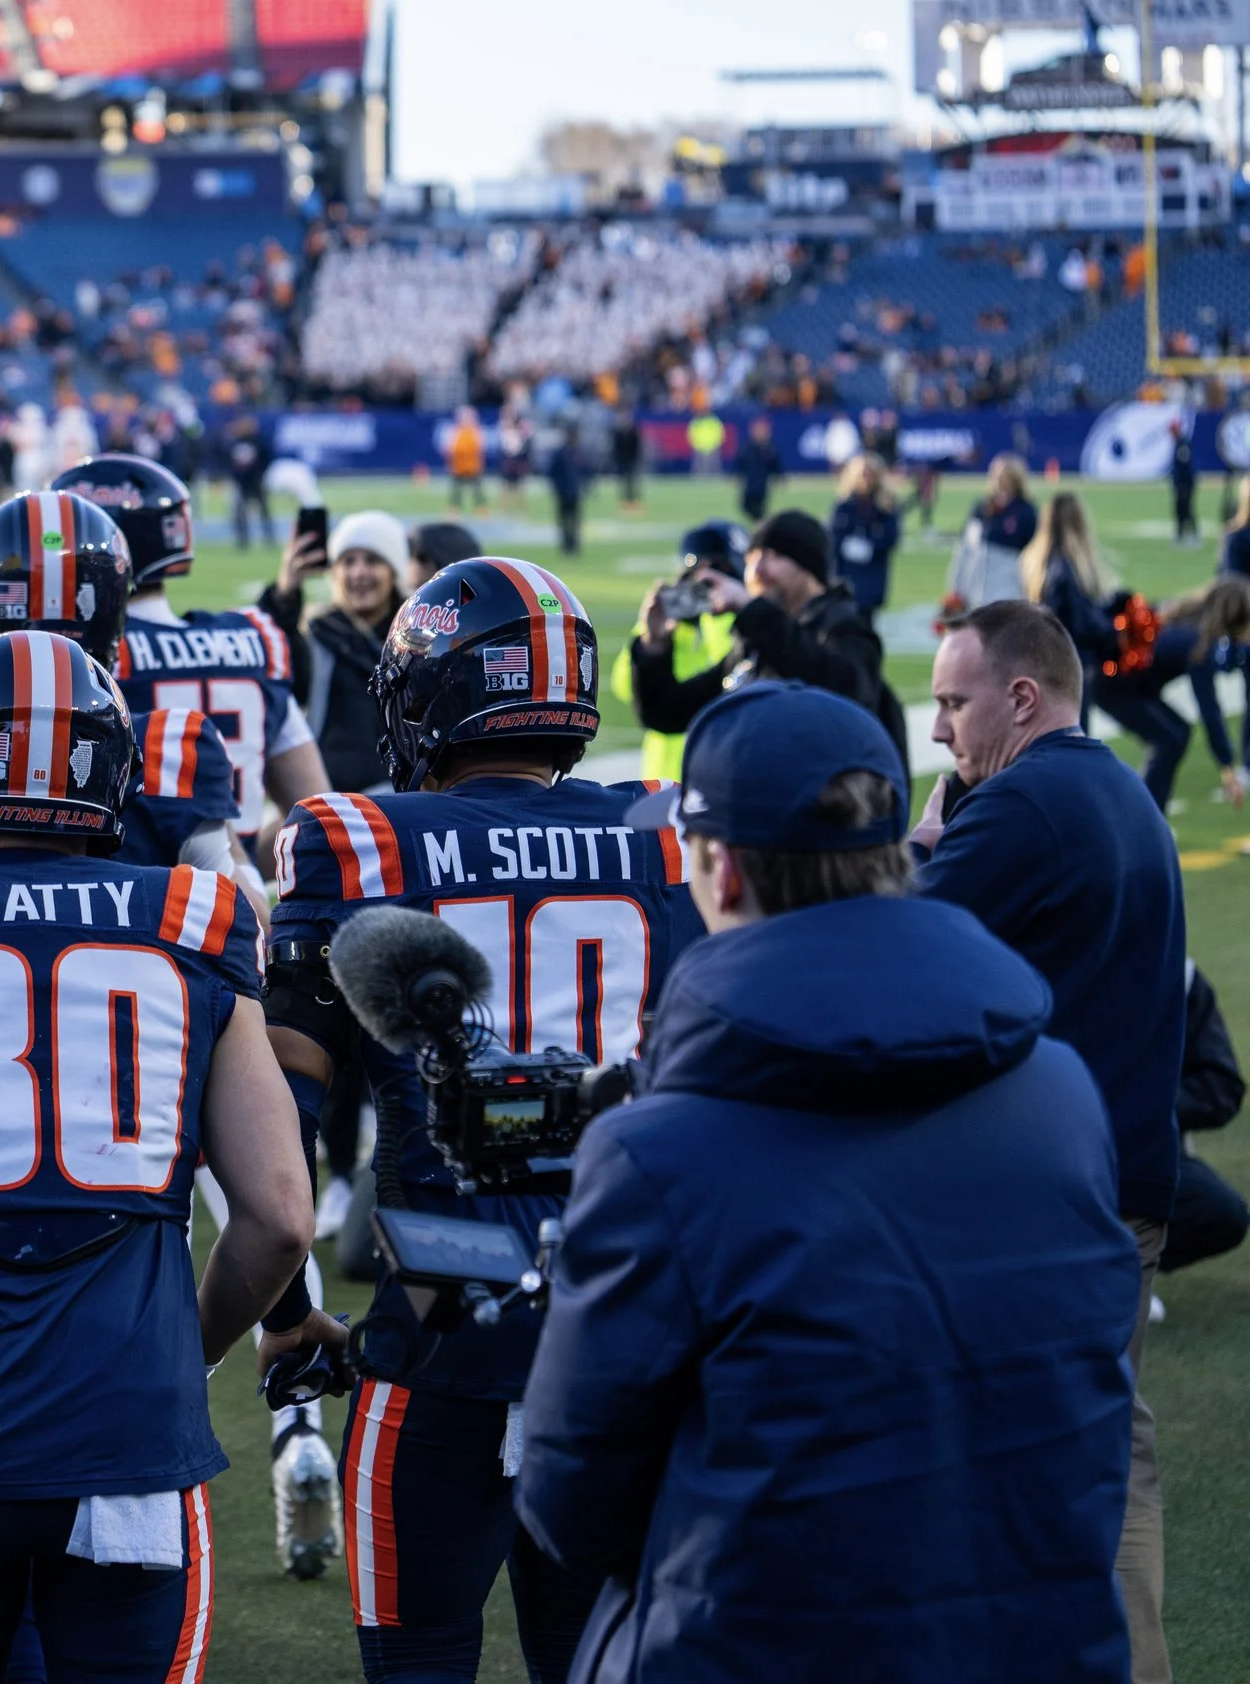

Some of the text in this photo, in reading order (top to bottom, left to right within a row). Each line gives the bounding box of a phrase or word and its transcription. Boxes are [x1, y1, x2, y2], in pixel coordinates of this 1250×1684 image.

[541, 598, 559, 608] C2P
[126, 628, 266, 671] H. CLEMENT
[555, 676, 564, 685] 10
[483, 711, 569, 732] FIGHTING
[34, 769, 47, 780] 80
[53, 810, 105, 829] ILLINI
[422, 826, 635, 887] M. SCOTT
[433, 894, 651, 1067] 10
